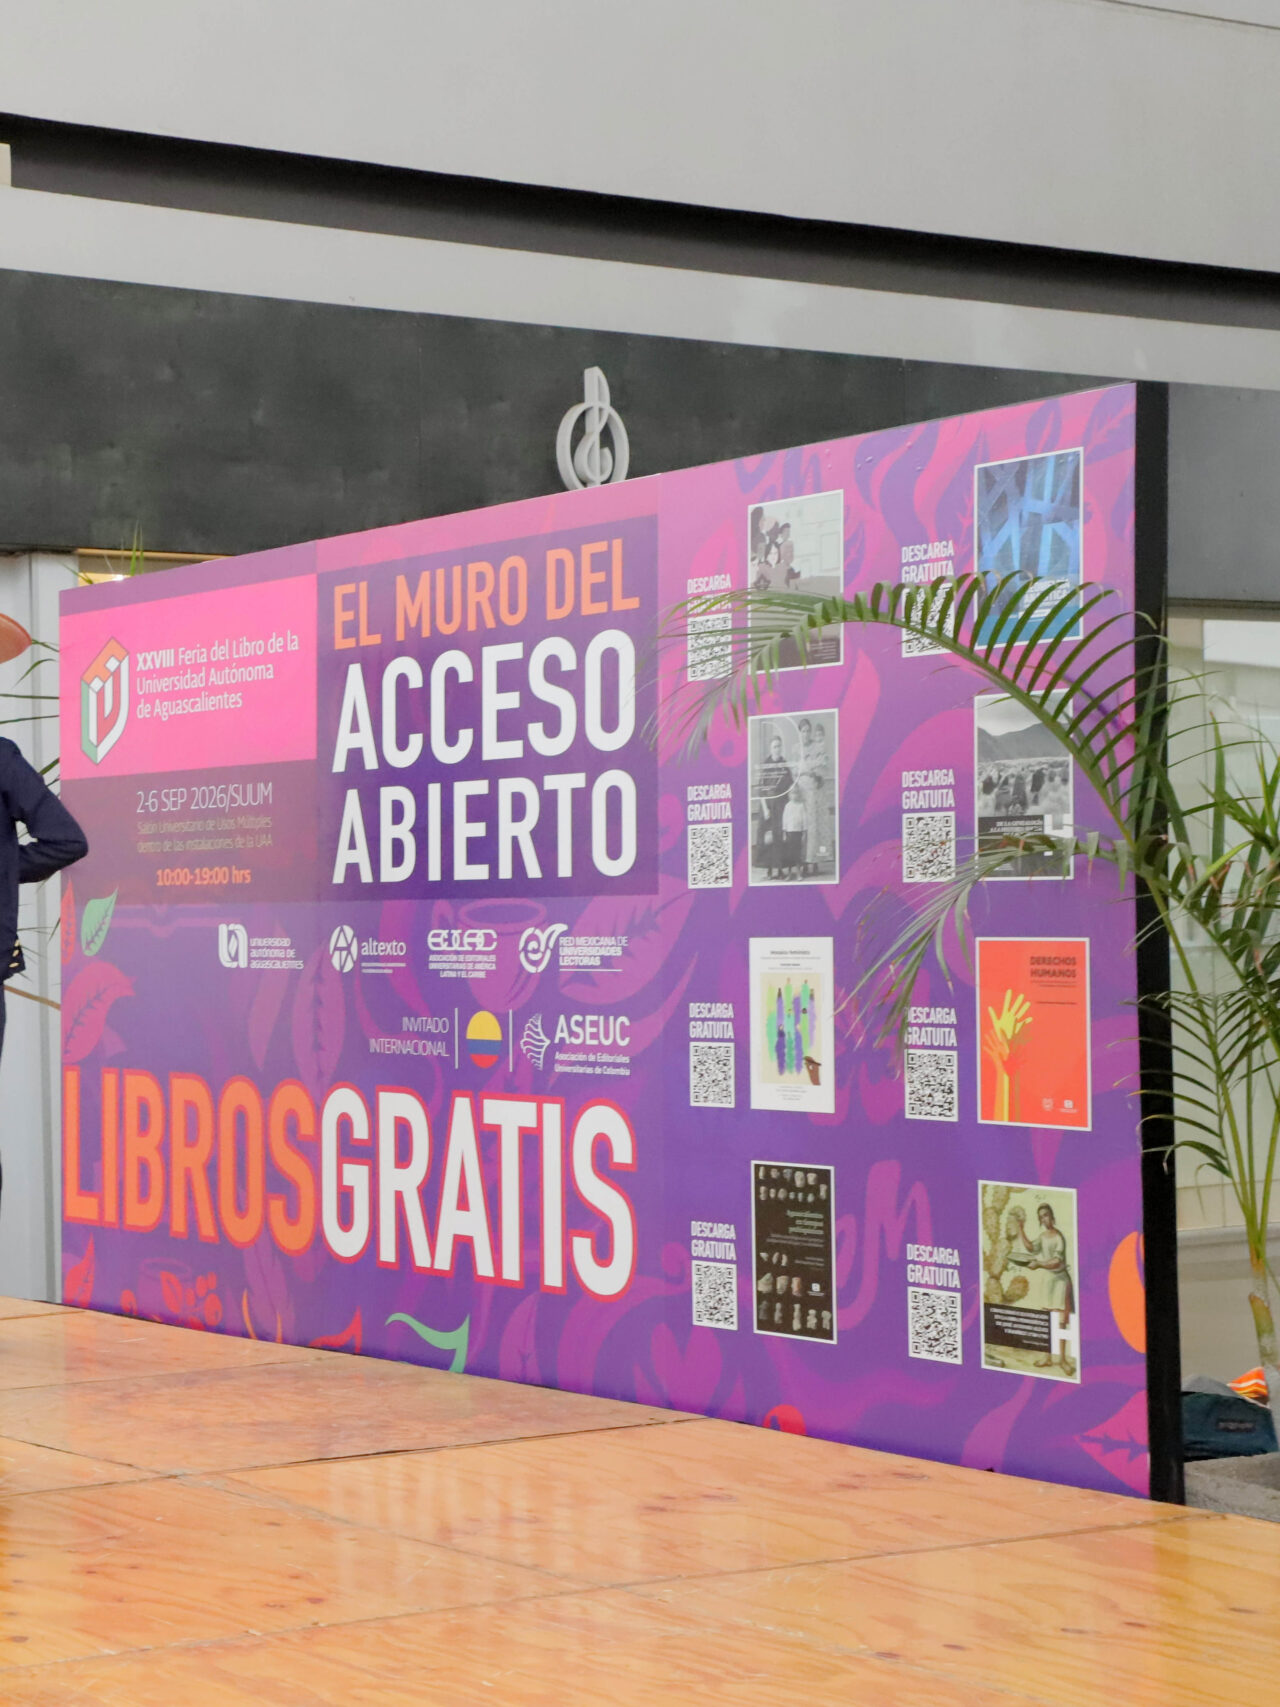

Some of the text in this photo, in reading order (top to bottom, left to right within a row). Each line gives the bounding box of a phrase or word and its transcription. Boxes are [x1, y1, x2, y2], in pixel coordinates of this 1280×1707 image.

[901, 540, 955, 563] DESCARGA
[687, 573, 732, 594] DESCARGA
[901, 560, 955, 584] GRATUITA
[333, 539, 640, 650] EL MURO DEL
[136, 630, 299, 671] XXVIII Feria del Libro de la
[136, 663, 274, 695] Universidad Autónoma
[136, 692, 243, 721] de Aguascalientes
[331, 628, 637, 774] ACCESO
[901, 769, 955, 788] DESCARGA
[136, 782, 273, 813] 2-6 SEP 2026/SUUM
[687, 783, 732, 801] DESCARGA
[901, 788, 956, 810] GRATUITA
[687, 801, 732, 822] GRATUITA
[331, 768, 638, 886] ABIERTO
[156, 865, 252, 886] 10:00-19:00 hrs
[361, 937, 407, 956] altexto
[559, 936, 629, 947] RED MEXICANA DE
[689, 1002, 735, 1019] DESCARGA
[402, 1016, 449, 1034] INVITADO
[554, 1014, 631, 1047] ASEUC
[689, 1020, 735, 1039] GRATUITA
[904, 1026, 958, 1047] GRATUITA
[369, 1038, 450, 1057] INTERNACIONAL
[62, 1066, 317, 1257] LIBROS
[320, 1083, 637, 1301] GRATIS
[691, 1220, 736, 1241] DESCARGA
[691, 1238, 737, 1261] GRATUITA
[906, 1243, 961, 1267] DESCARGA
[906, 1263, 961, 1289] GRATUITA
